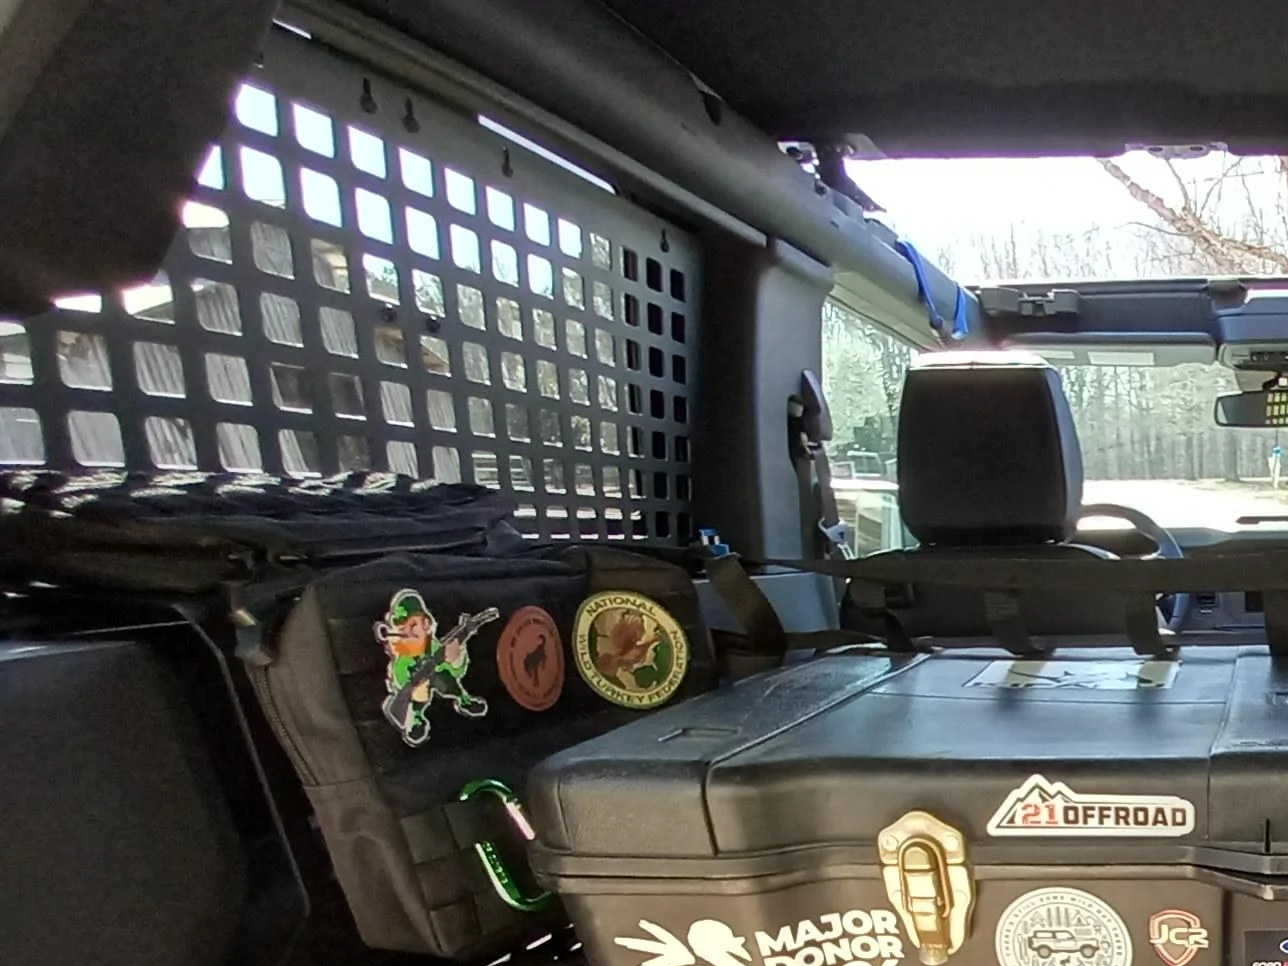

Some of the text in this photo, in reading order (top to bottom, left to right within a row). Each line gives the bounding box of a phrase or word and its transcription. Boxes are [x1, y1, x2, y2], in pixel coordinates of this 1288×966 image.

[586, 596, 657, 617] NATIONAL
[578, 633, 591, 670] WILD
[591, 672, 645, 703] TURKEY
[648, 630, 685, 702] FEDERATION
[1062, 805, 1187, 827] OFFROAD
[755, 910, 899, 956] MAJOR
[1149, 924, 1209, 948] JCR
